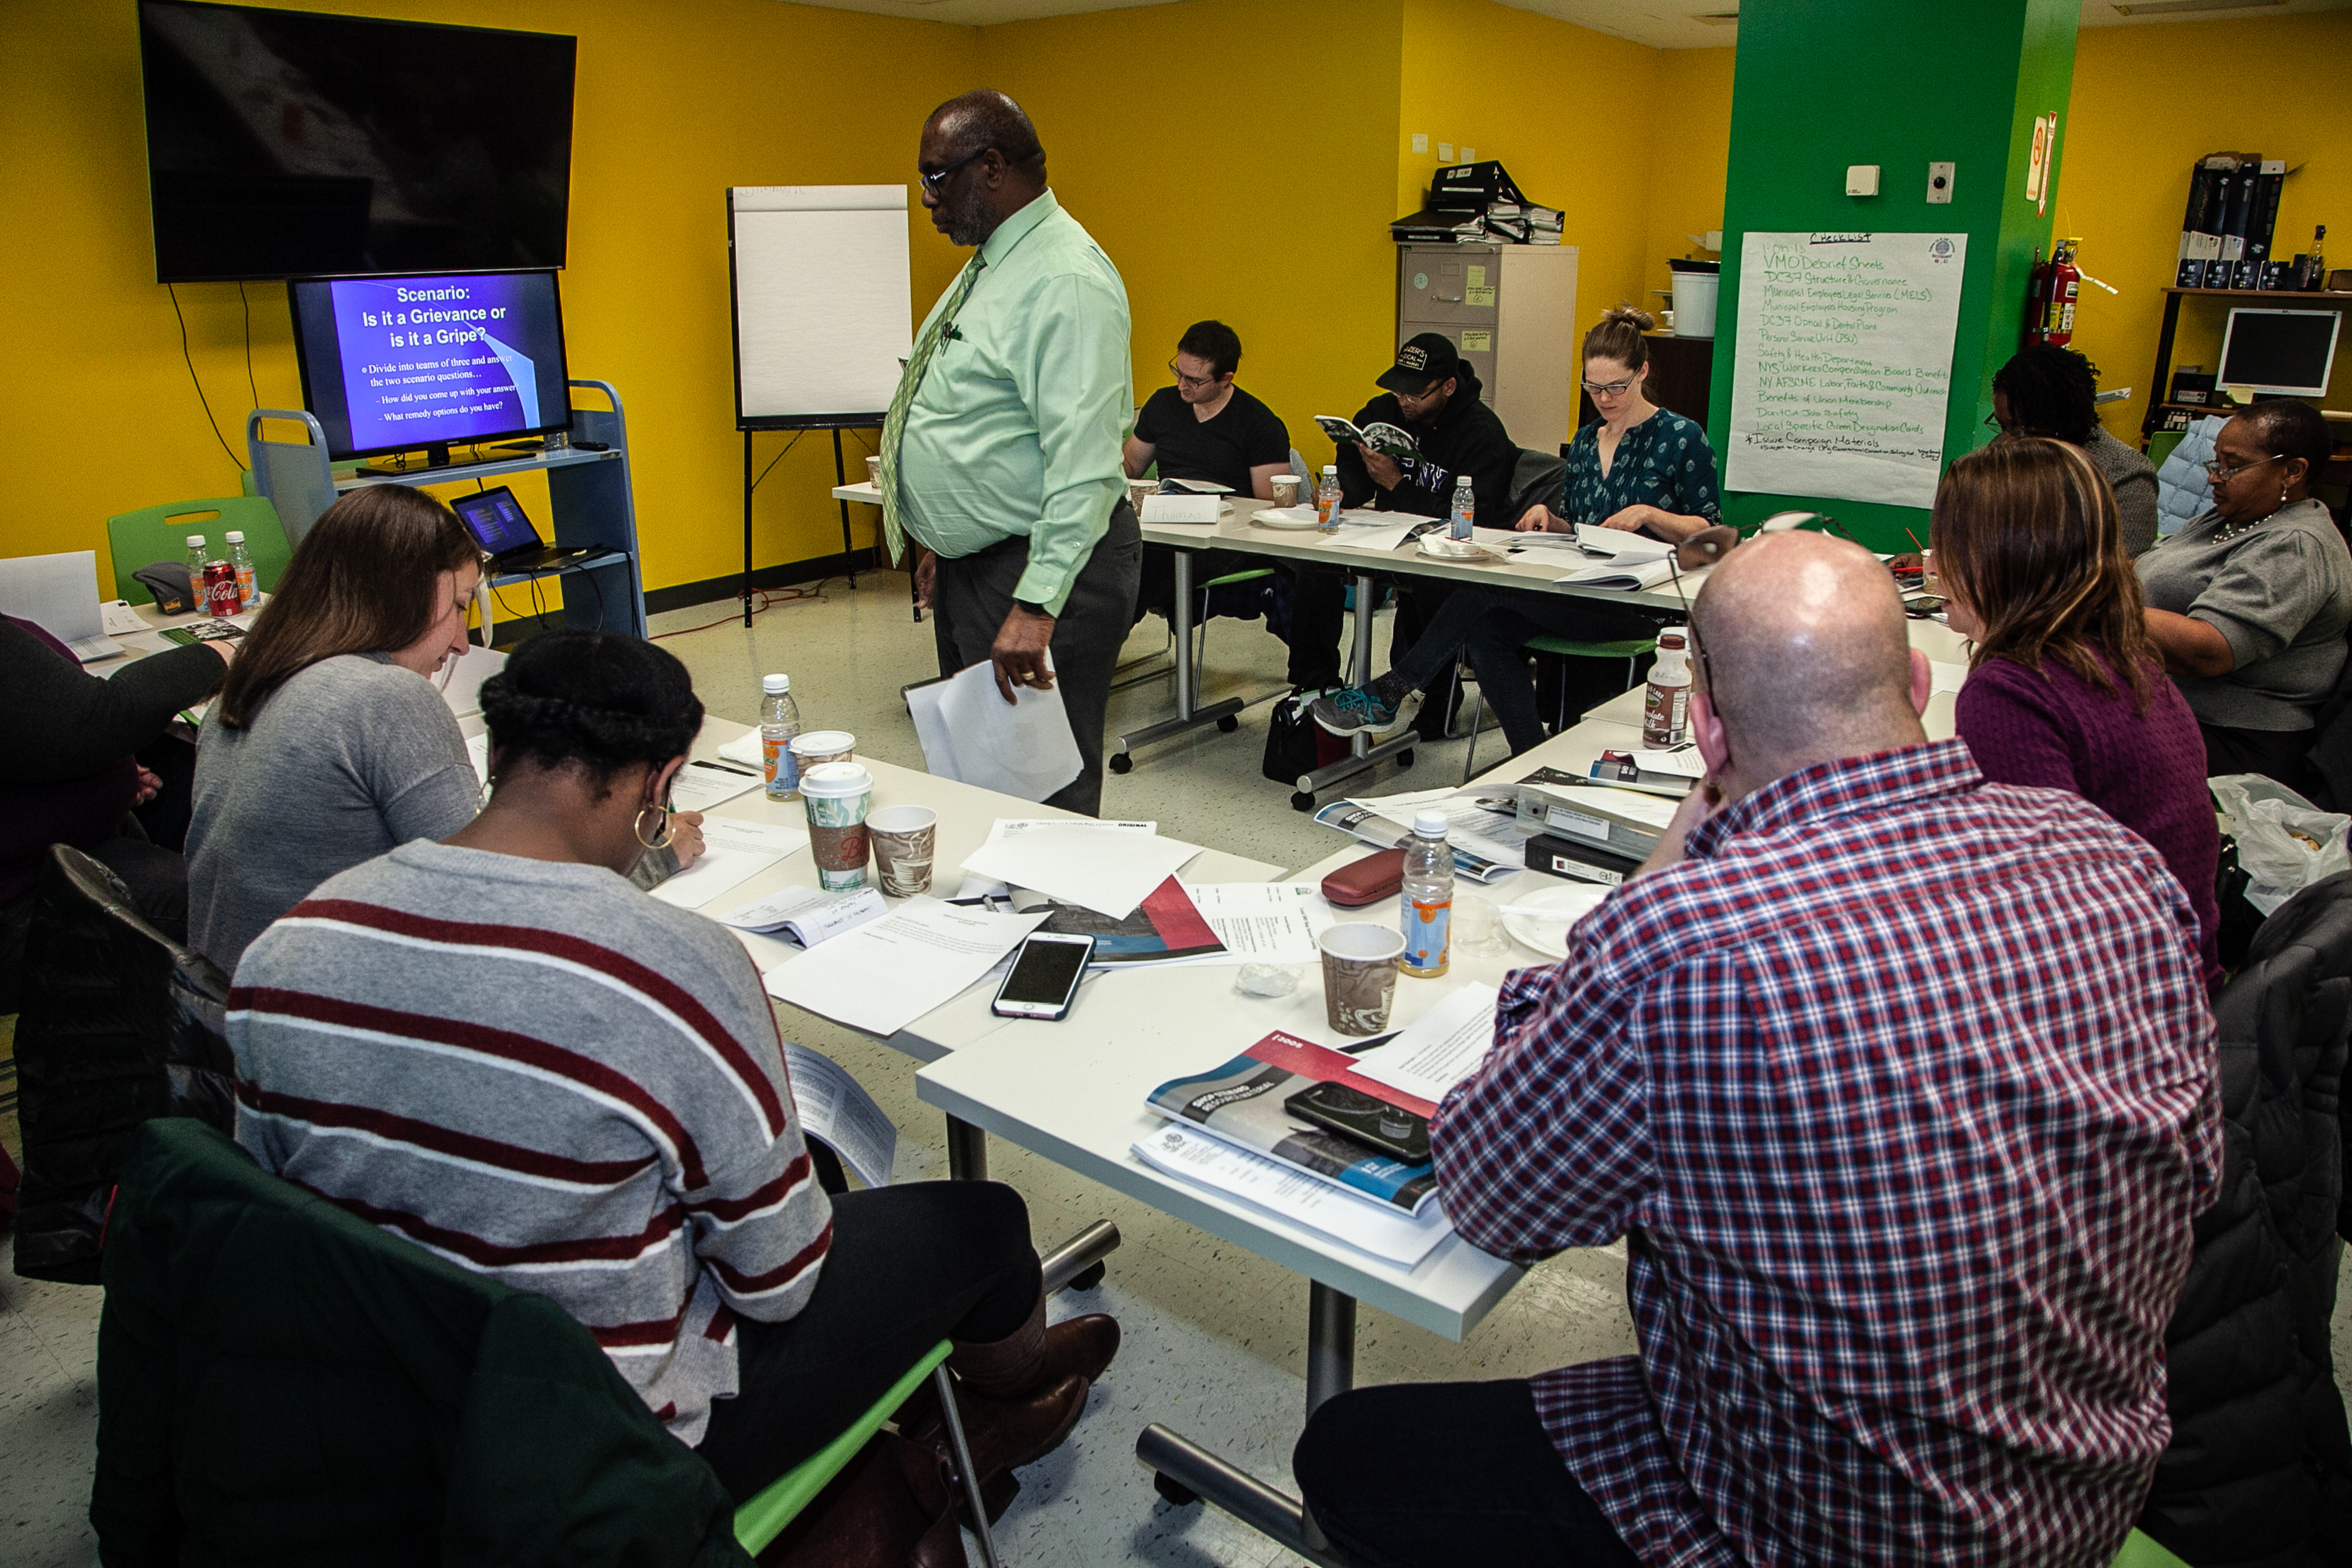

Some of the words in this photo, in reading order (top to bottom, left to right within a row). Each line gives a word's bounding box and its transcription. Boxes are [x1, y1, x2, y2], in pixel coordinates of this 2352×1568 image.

[1764, 253, 1800, 269] VMO
[1800, 255, 1846, 270] Debrief
[1849, 256, 1884, 270] Sheets
[1805, 272, 1846, 284] Structure
[1854, 274, 1907, 285] Governance
[397, 285, 470, 303] Scenario:
[1807, 287, 1842, 302] Employees
[1843, 289, 1863, 303] Legal
[1894, 287, 1932, 302] (MELS)
[1762, 298, 1798, 312] Municipal
[1801, 302, 1836, 313] Employees
[1838, 300, 1865, 317] Housing
[1864, 302, 1898, 317] Program
[363, 312, 377, 327] Is
[382, 310, 393, 326] it
[397, 313, 407, 325] a
[410, 308, 487, 324] Grievance
[490, 307, 506, 319] or
[1794, 315, 1822, 328] Optical
[1831, 317, 1855, 330] Dental
[1857, 319, 1877, 330] Plans
[390, 332, 404, 348] is
[408, 331, 419, 347] it
[423, 333, 433, 345] a
[436, 326, 486, 346] Gripe?
[1757, 343, 1785, 363] Safety
[1795, 349, 1822, 362] Health
[1821, 352, 1873, 366] Department
[368, 362, 397, 374] Divide
[398, 361, 414, 373] into
[416, 360, 439, 371] teams
[441, 359, 449, 369] of
[451, 358, 470, 368] three
[471, 355, 486, 365] and
[487, 355, 513, 364] answer
[1758, 361, 1780, 375] NYS
[1822, 364, 1881, 375] Compensation
[1883, 366, 1911, 376] Board
[1915, 368, 1949, 379] Benefits
[370, 377, 384, 387] the
[385, 377, 401, 386] two
[402, 372, 435, 385] scenario
[1759, 376, 1772, 389] NY
[1777, 377, 1816, 388] AFSCME
[1844, 378, 1869, 388] Faith
[1875, 381, 1913, 397] Community
[381, 396, 399, 405] How
[401, 393, 413, 402] did
[414, 394, 428, 403] you
[429, 390, 448, 400] come
[449, 390, 458, 399] up
[459, 387, 475, 396] with
[476, 388, 491, 397] your
[1756, 390, 1798, 402] Benefits
[1803, 394, 1811, 403] of
[1839, 395, 1892, 409] Membership
[384, 412, 404, 422] What
[405, 409, 431, 421] remedy
[433, 406, 458, 417] options
[459, 405, 468, 414] do
[469, 404, 482, 414] you
[483, 401, 503, 411] have?
[1824, 408, 1858, 422] Safety
[1757, 421, 1783, 432] Local
[1785, 420, 1824, 432] Specific
[1852, 421, 1899, 436] Designation
[1900, 422, 1924, 434] Cards
[1786, 432, 1832, 446] Campaign
[1835, 435, 1879, 447] Materials
[1151, 505, 1201, 521] Thomas
[1192, 1093, 1215, 1107] SHOP
